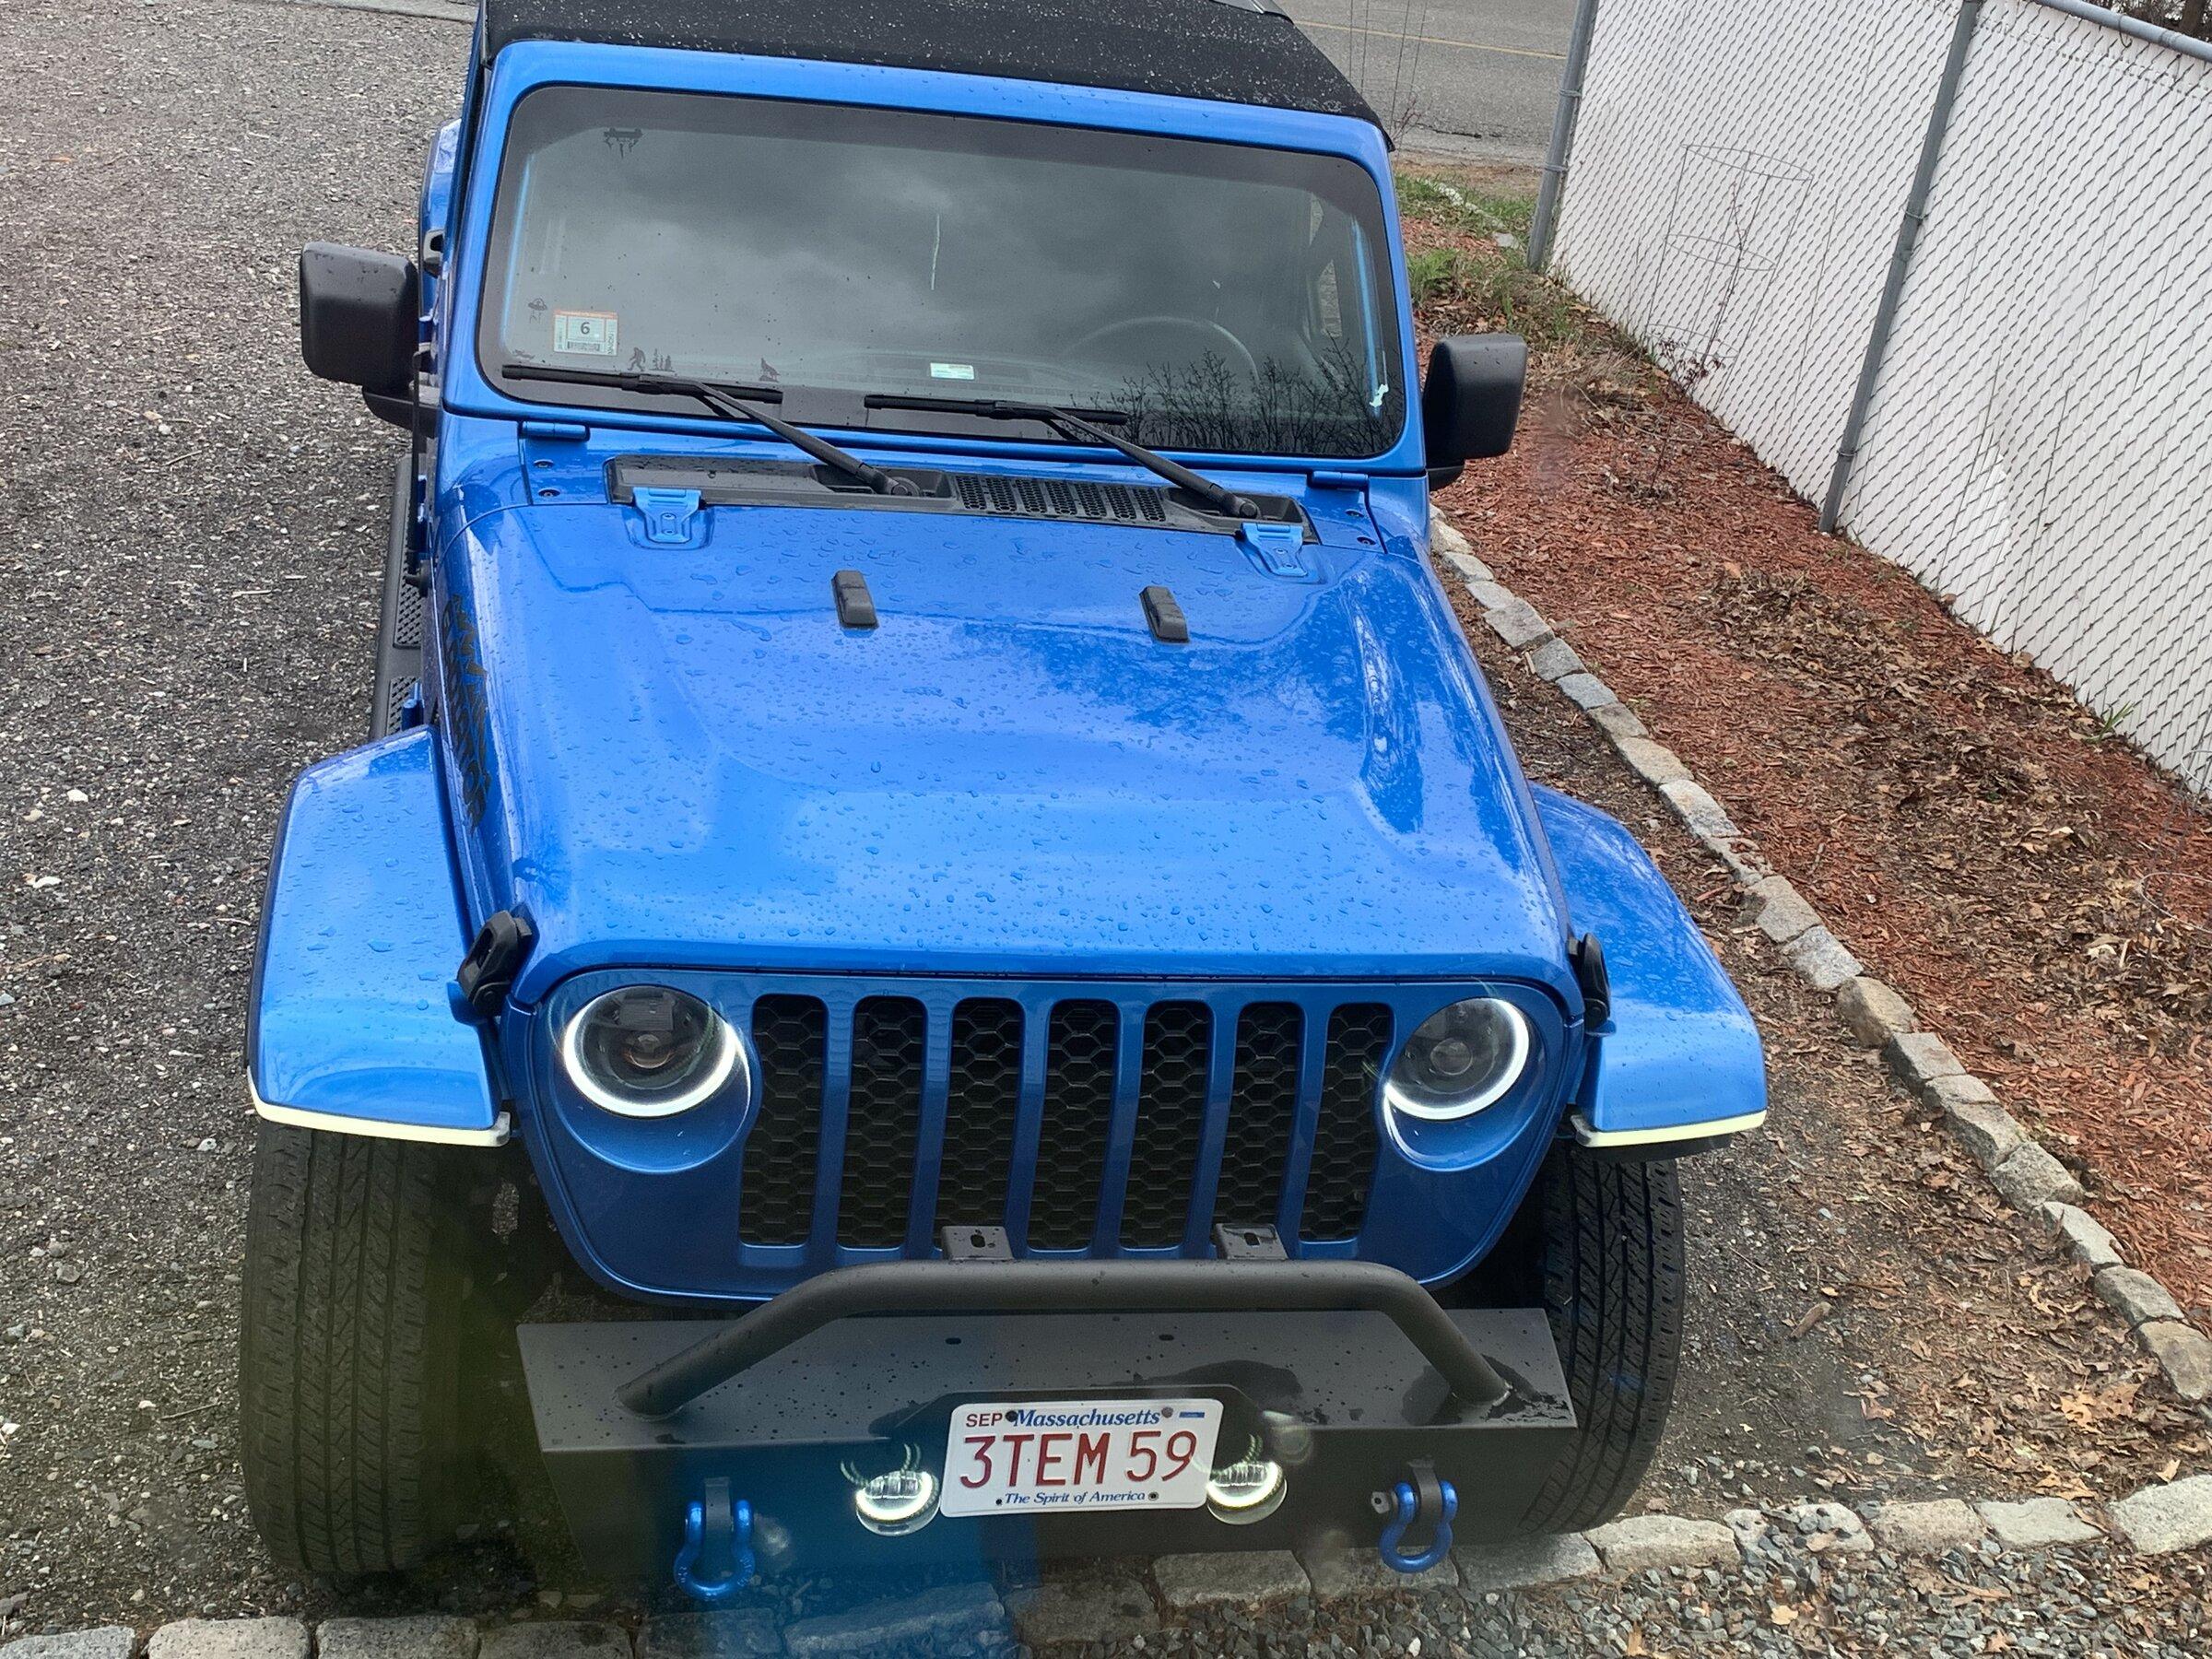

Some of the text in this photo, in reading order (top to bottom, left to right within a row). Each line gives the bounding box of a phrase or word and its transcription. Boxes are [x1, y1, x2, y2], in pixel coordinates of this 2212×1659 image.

[580, 322, 591, 335] 6
[966, 1408, 1160, 1428] SEP Massachusetts
[959, 1430, 1197, 1488] 3TEM 59
[1005, 1489, 1146, 1505] The Spirit of America
